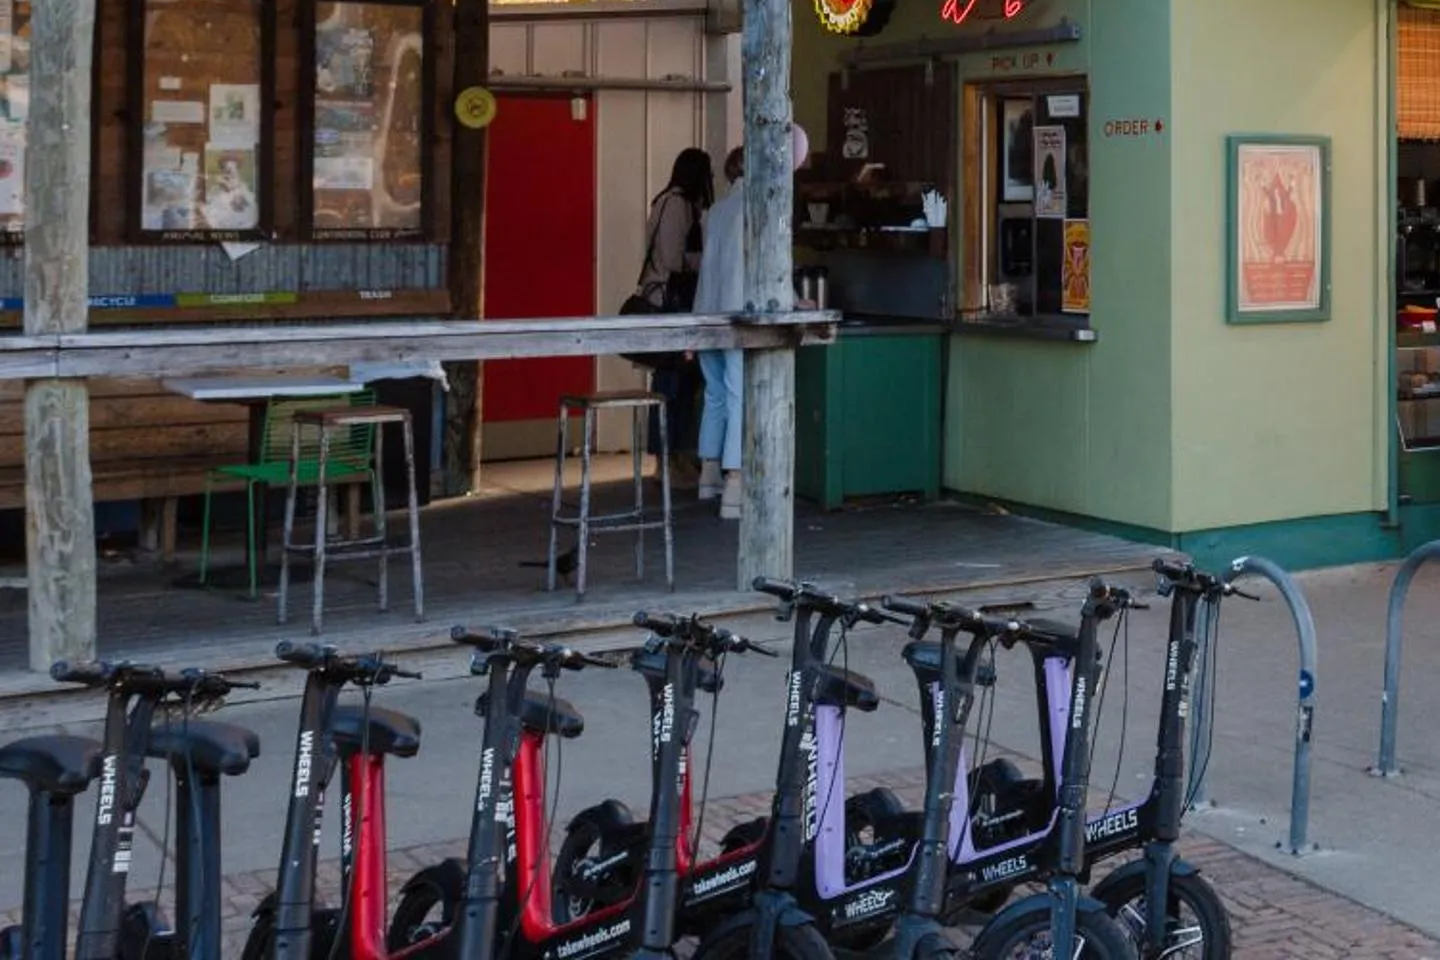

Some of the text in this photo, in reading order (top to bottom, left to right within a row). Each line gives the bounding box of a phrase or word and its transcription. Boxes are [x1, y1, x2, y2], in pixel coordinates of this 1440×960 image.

[991, 53, 1039, 70] PICK UP
[1103, 120, 1149, 136] ORDER
[660, 682, 674, 742] WHEELS
[787, 671, 801, 727] WHEELS
[1072, 676, 1086, 729] WHEELS
[294, 730, 315, 798] WHEELS
[98, 754, 118, 825] WHEELS
[1084, 808, 1138, 842] WHEELS
[693, 859, 758, 895] takewheels.com
[982, 854, 1028, 882] WHEELS
[844, 895, 887, 920] WHEELS
[556, 918, 631, 959] takewheels.com
